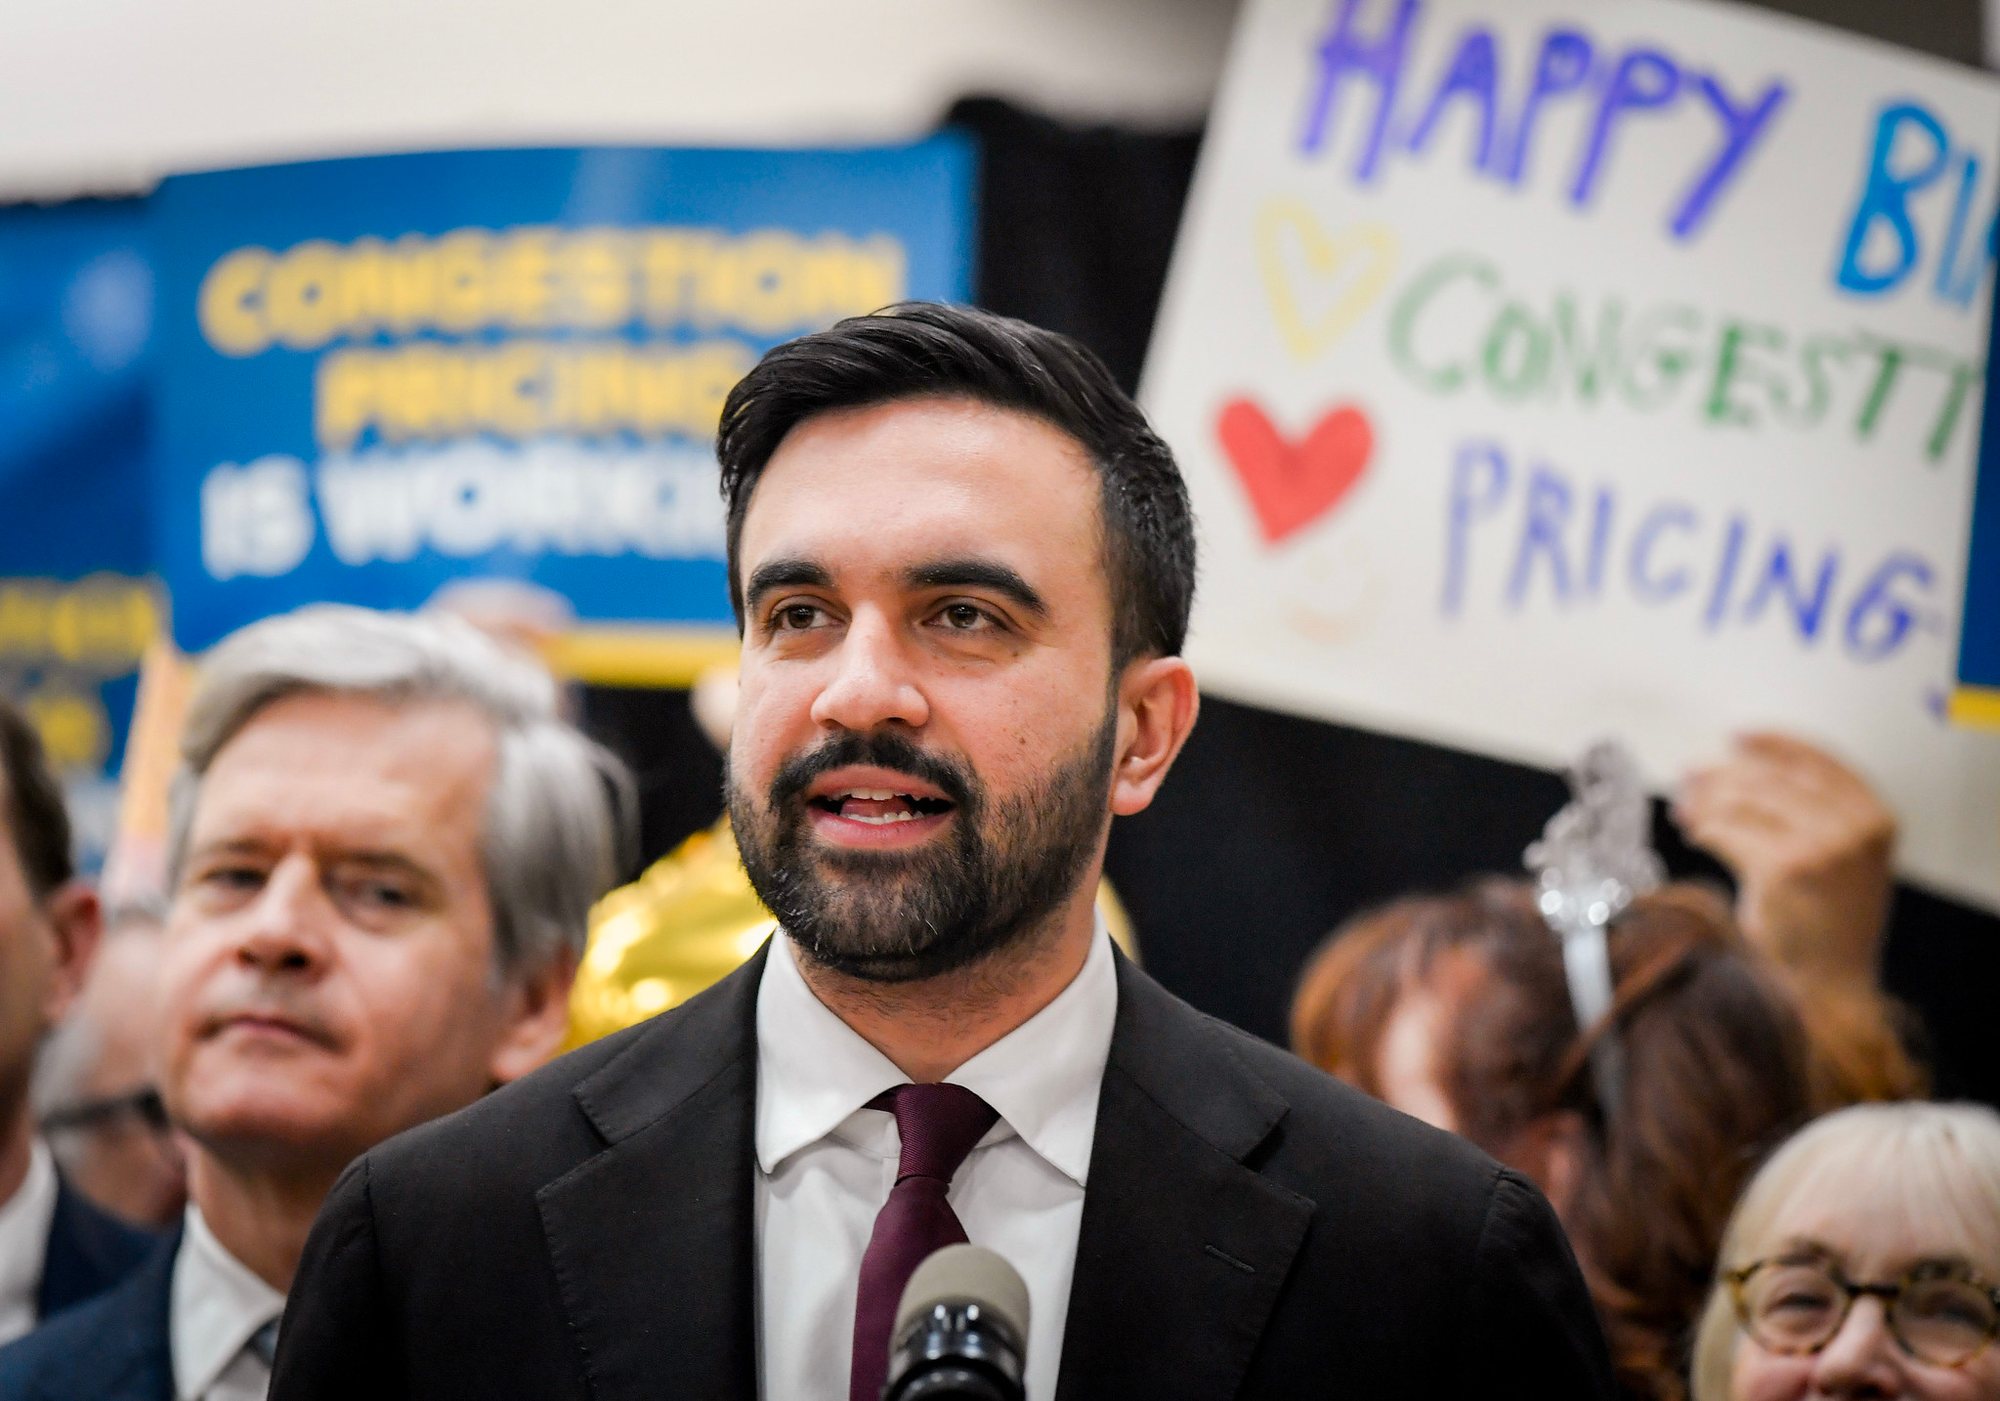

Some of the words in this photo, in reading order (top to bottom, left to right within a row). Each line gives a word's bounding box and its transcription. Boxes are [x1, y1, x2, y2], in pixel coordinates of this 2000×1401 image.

[1297, 0, 1789, 239] HAPPY
[1836, 100, 1996, 308] BI
[200, 227, 903, 355] CONGESTION
[203, 455, 312, 580] IS
[1438, 438, 1937, 663] PRICING
